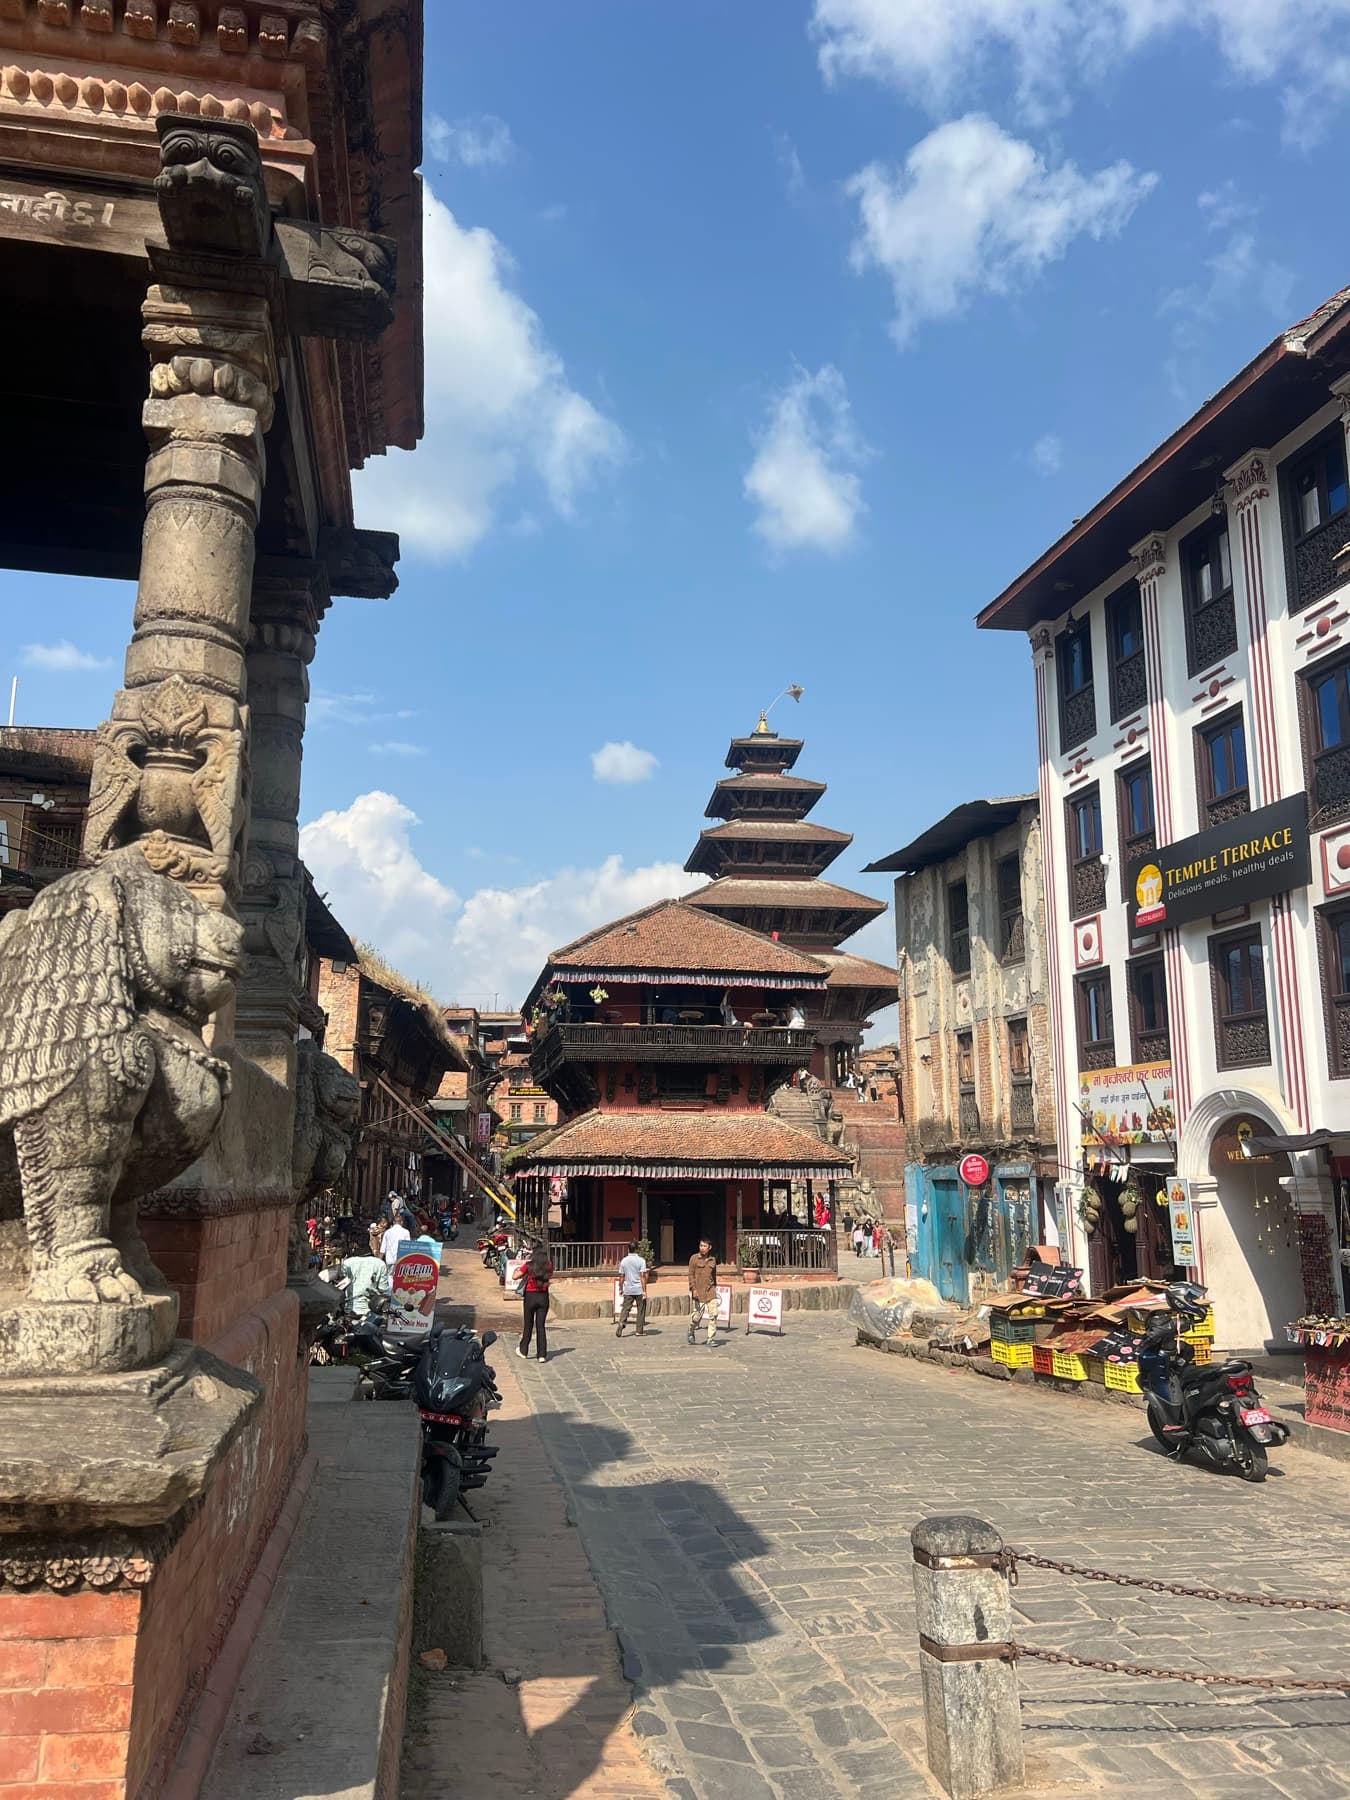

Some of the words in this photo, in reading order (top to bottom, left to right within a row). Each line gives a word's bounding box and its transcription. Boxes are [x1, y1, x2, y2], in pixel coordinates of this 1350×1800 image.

[1165, 855, 1218, 887] TEMPLE
[1220, 827, 1293, 867] TERRACE
[1168, 882, 1203, 901] Delicious
[1232, 860, 1266, 879] healthy
[1268, 850, 1294, 866] deals
